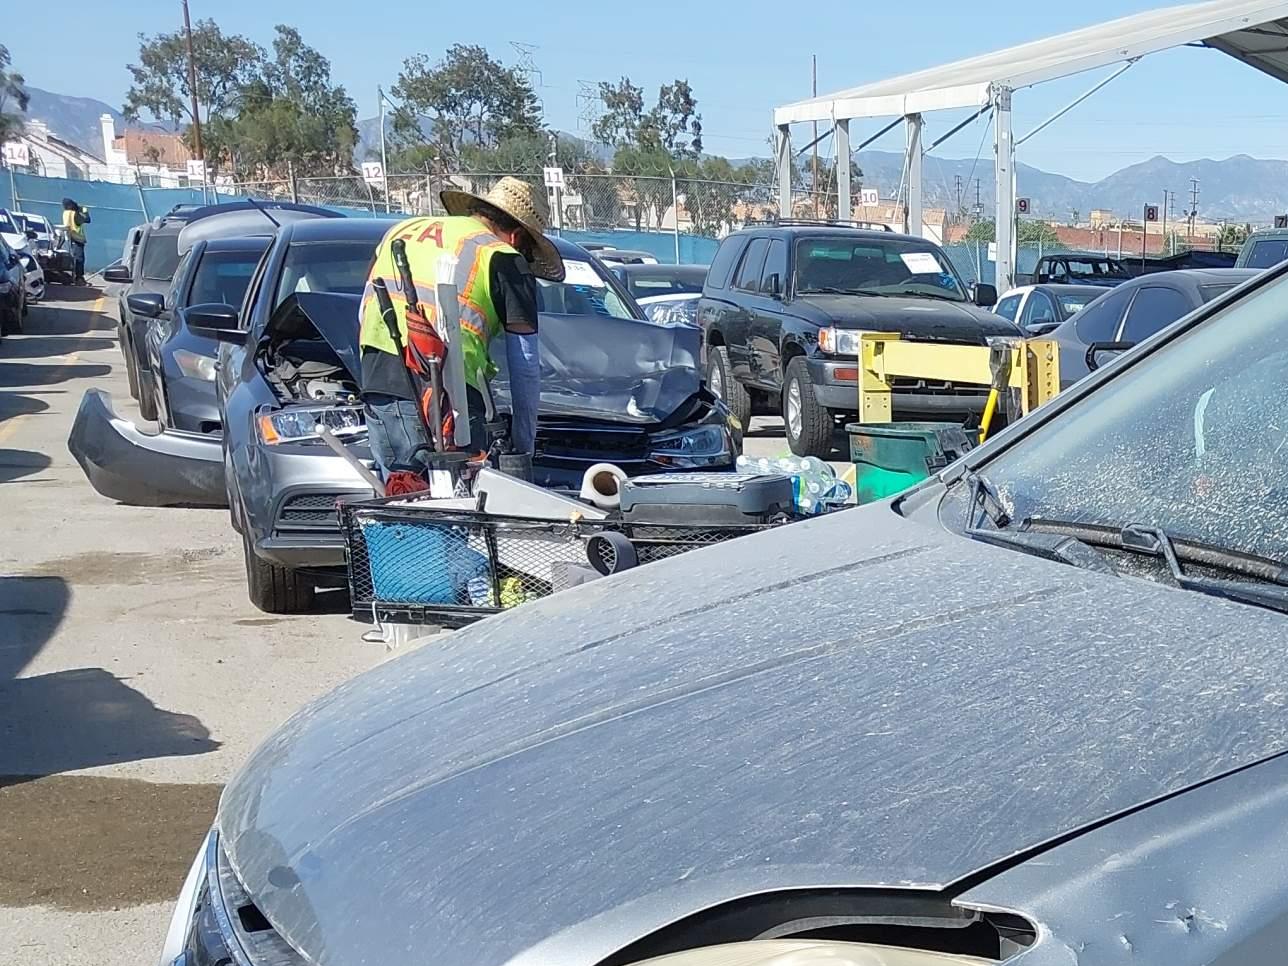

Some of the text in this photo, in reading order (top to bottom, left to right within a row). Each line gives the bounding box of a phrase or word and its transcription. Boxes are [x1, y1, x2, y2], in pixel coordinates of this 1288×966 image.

[7, 147, 26, 161] 14
[364, 166, 382, 179] 12
[545, 171, 562, 183] 11
[862, 192, 877, 203] 10
[1019, 199, 1027, 212] 9
[1147, 207, 1155, 220] 8
[1278, 217, 1285, 228] 7
